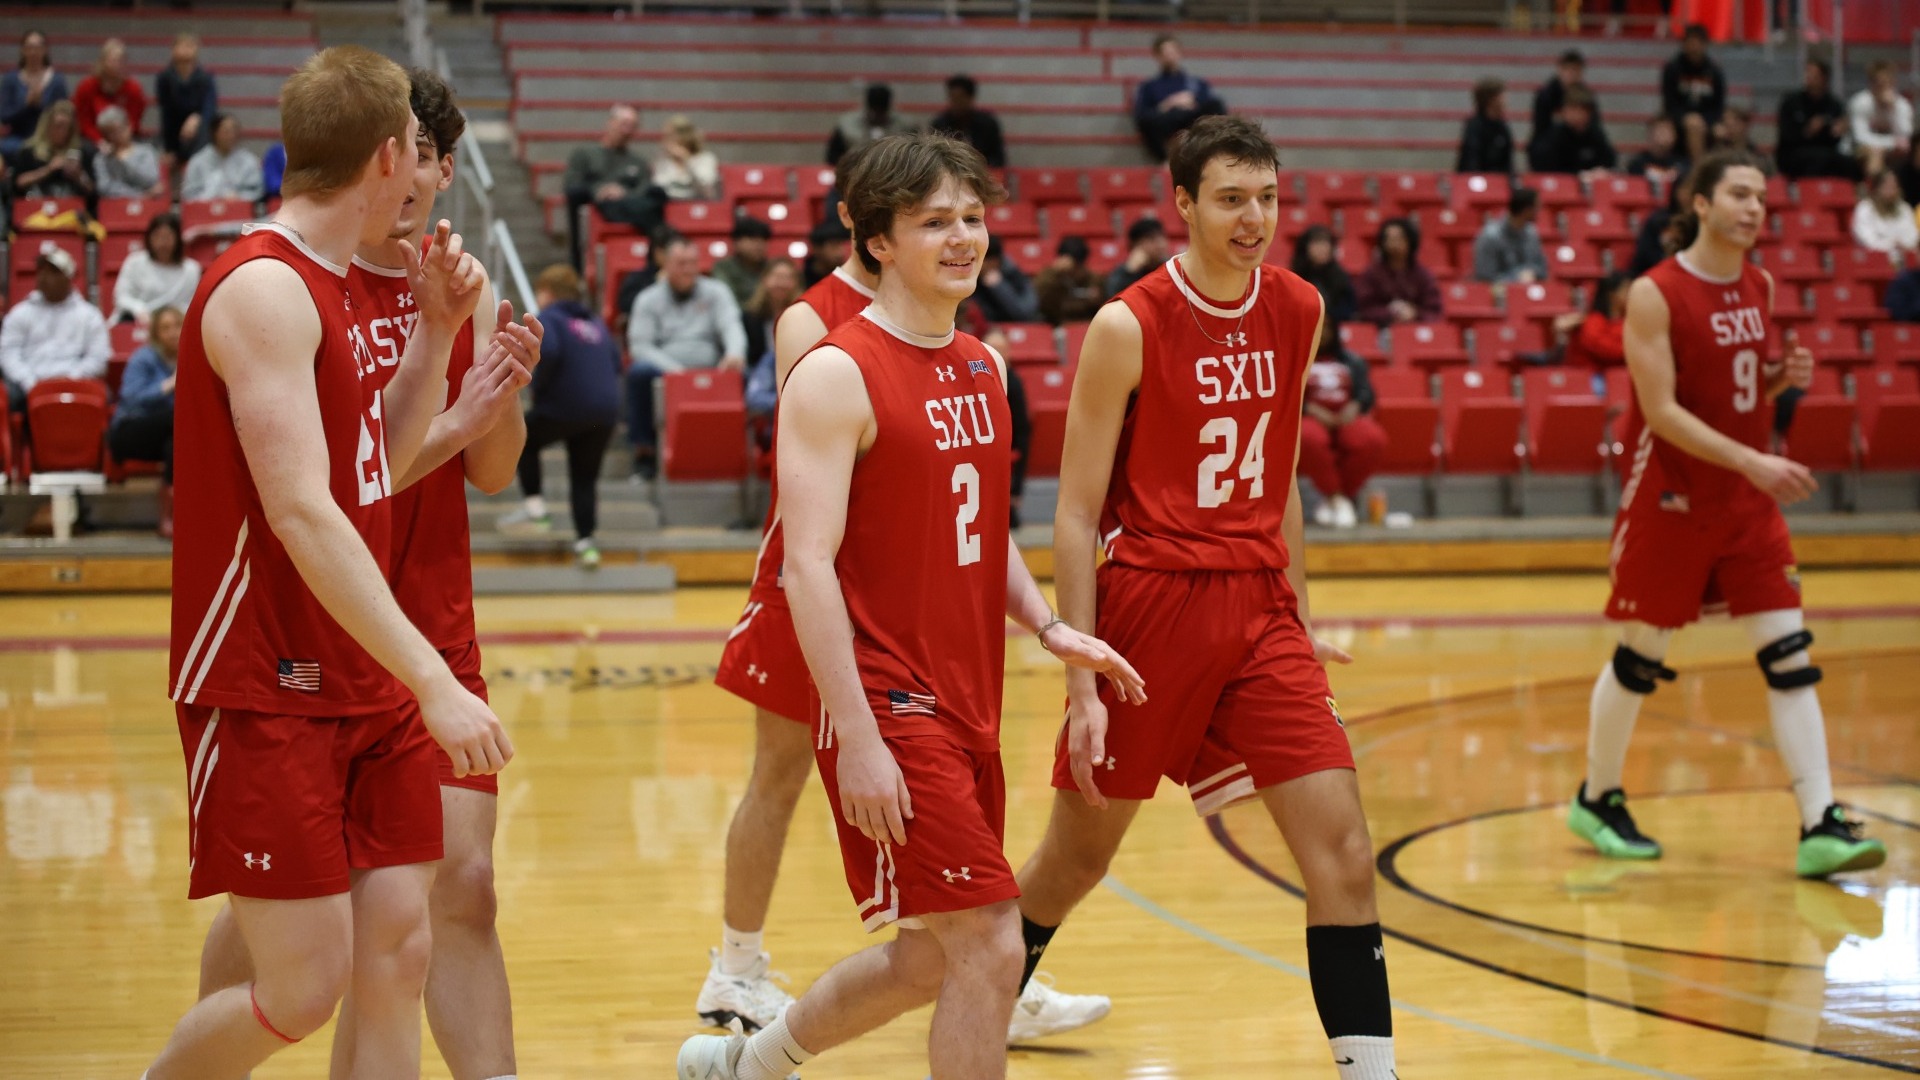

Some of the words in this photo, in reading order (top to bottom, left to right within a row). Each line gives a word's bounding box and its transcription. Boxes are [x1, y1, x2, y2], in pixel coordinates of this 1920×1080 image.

[1710, 307, 1765, 346] SXU
[1196, 351, 1276, 404] SXU
[1732, 349, 1758, 413] 9
[925, 394, 995, 450] SXU
[1198, 411, 1272, 508] 24
[952, 463, 980, 566] 2
